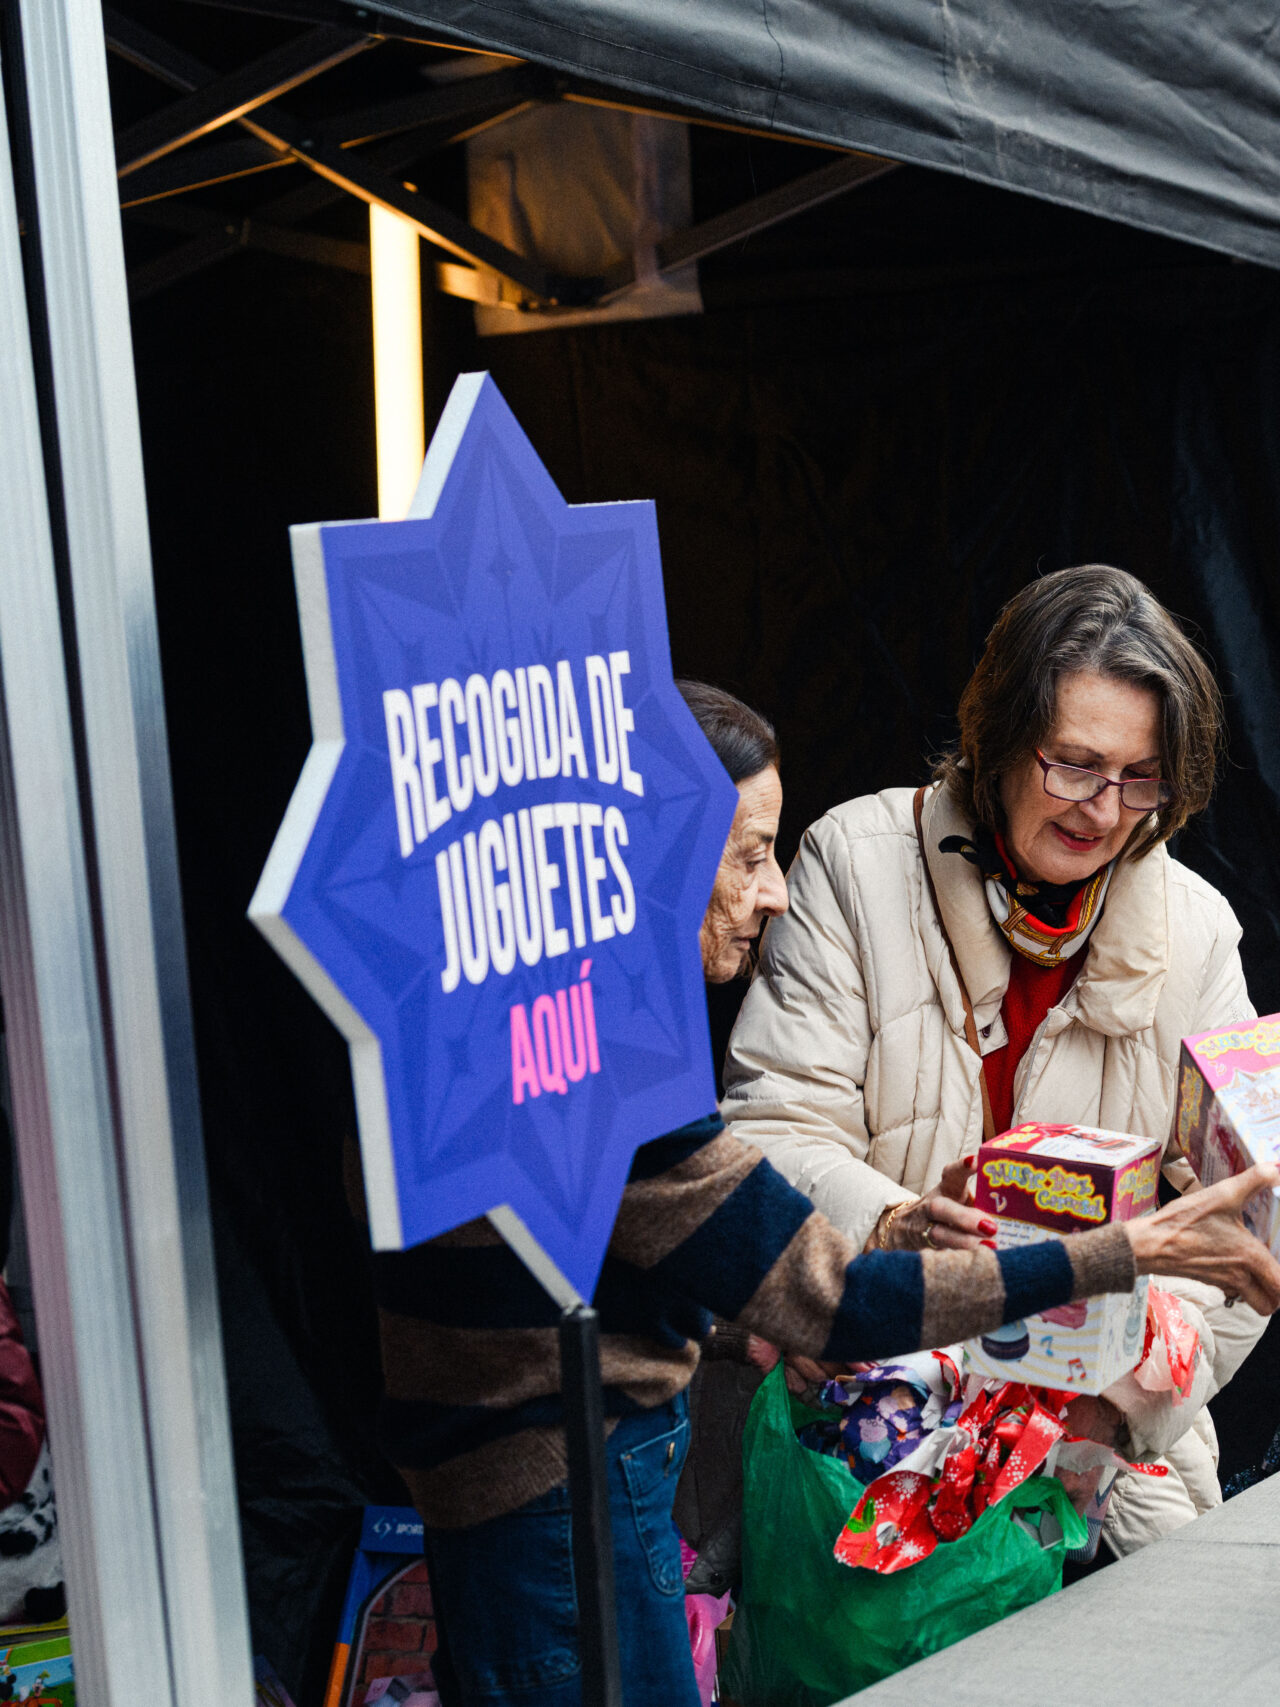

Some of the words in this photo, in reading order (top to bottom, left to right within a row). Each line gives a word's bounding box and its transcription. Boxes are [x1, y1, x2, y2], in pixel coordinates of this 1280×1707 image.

[383, 659, 589, 859] RECOGIDA
[585, 650, 645, 798] DE
[435, 802, 637, 994] JUGUETES
[510, 958, 601, 1106] AQUÍ
